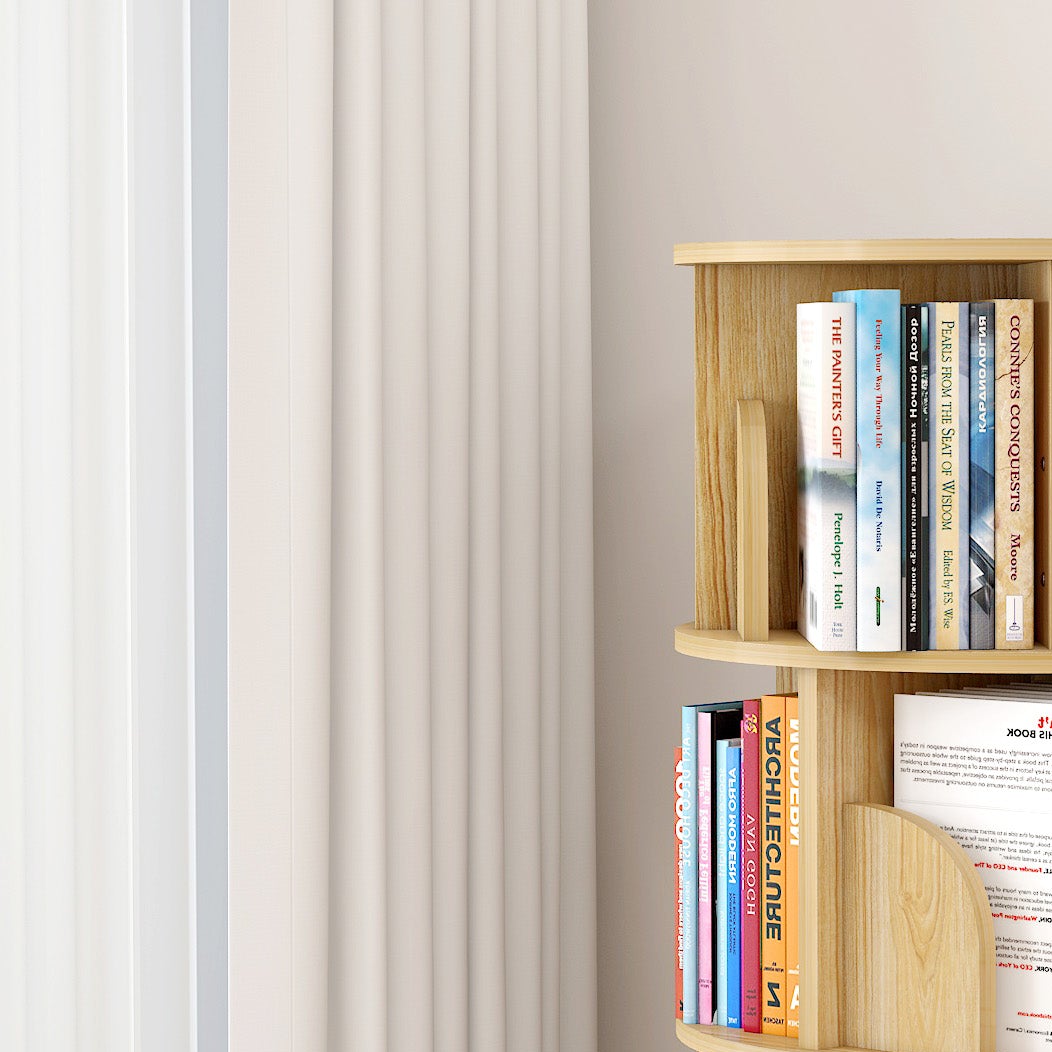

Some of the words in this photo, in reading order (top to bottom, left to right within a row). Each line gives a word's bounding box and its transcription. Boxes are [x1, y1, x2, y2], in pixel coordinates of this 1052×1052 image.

[832, 316, 843, 345] THE
[873, 319, 884, 350] Feeling
[908, 318, 919, 361] Дозор
[940, 320, 956, 362] PEARLS
[874, 352, 884, 372] Your
[1008, 315, 1021, 400] CONNIE'S
[832, 350, 843, 421] PAINTER'S
[874, 375, 883, 391] Way
[940, 367, 953, 398] FROM
[978, 315, 988, 433] КАРДИОЛОГИЯ
[908, 365, 918, 418] Ночной
[874, 394, 884, 430] Through
[941, 402, 953, 424] THE
[832, 425, 843, 458] GIFT
[875, 433, 884, 448] Life
[940, 428, 956, 458] SEAT
[941, 461, 953, 477] OF
[1008, 404, 1021, 512] CONQUESTS
[875, 480, 884, 504] David
[940, 480, 956, 531] WISDOM
[875, 507, 883, 519] De
[831, 513, 844, 567] Penelope
[875, 522, 883, 552] Notaris
[942, 550, 954, 576] Edited
[1010, 534, 1021, 581] Moore
[832, 571, 843, 580] J.
[940, 579, 954, 589] by
[834, 584, 844, 610] Holt
[942, 608, 954, 629] Wise
